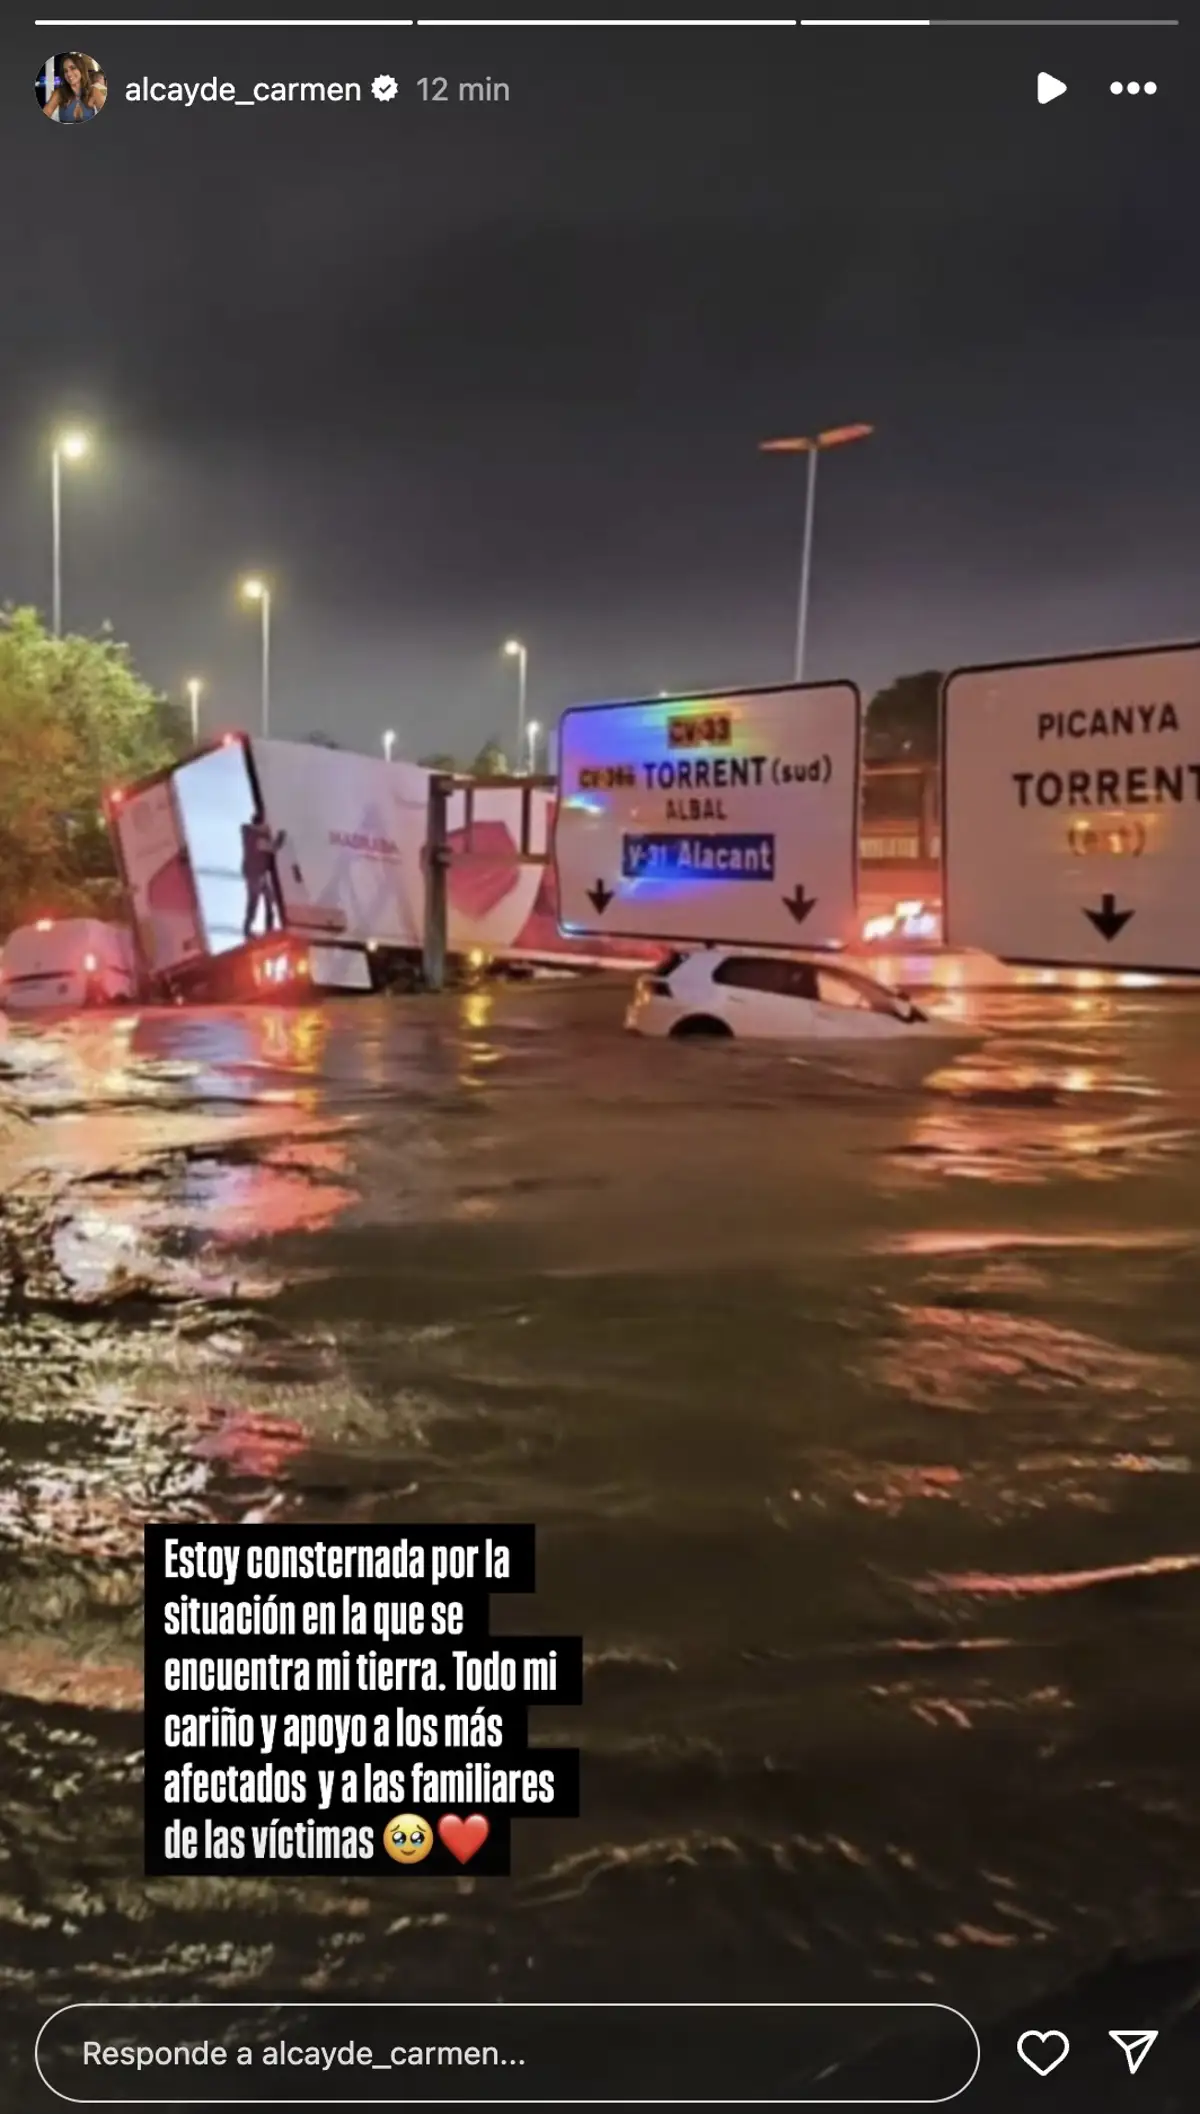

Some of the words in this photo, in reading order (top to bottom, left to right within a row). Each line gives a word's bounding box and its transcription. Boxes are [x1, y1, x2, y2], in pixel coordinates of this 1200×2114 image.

[1038, 702, 1179, 740] PICANYA
[643, 756, 767, 790] TORRENT
[771, 754, 832, 785] (sud)
[1013, 764, 1200, 808] TORRENT
[665, 799, 728, 821] ALBAL
[627, 844, 668, 870] V-31
[676, 839, 771, 870] Alacant
